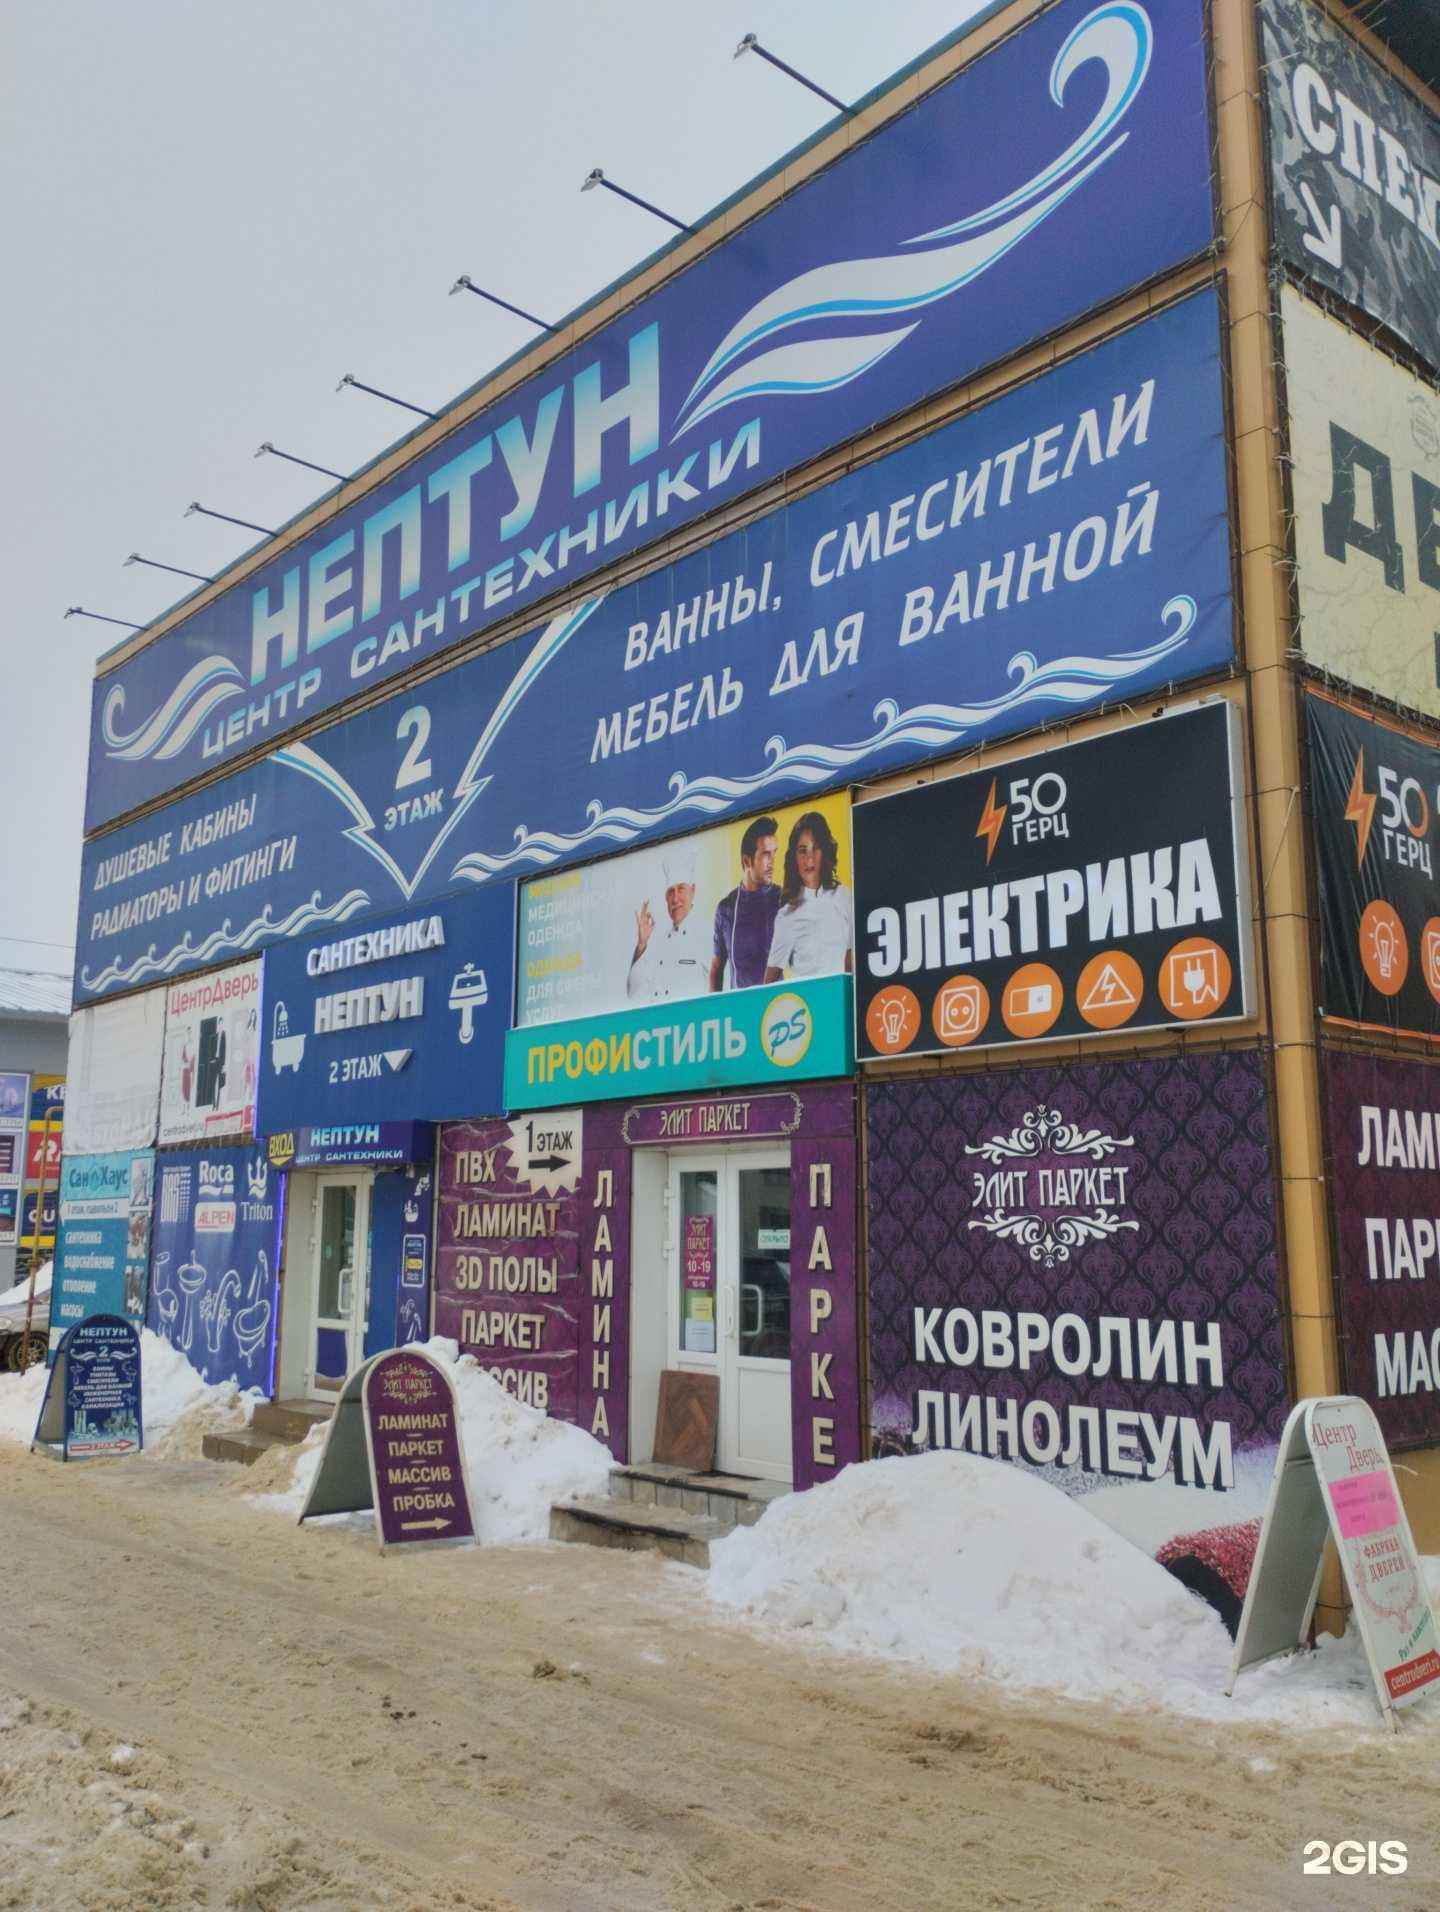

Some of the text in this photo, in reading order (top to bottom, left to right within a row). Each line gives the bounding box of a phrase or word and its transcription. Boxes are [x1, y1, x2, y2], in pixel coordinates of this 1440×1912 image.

[251, 321, 660, 688] НЕПТУН
[624, 380, 1155, 671] ВАННЫ, СМЕСИТЕЛИ
[203, 418, 761, 760] ЦЕНТР САНТЕХНИКИ
[590, 481, 1160, 764] МЕБЕЛЬ ДЛЯ ВАННОЙ
[396, 705, 432, 790] 2
[384, 788, 445, 832] ЭТАЖ
[1009, 772, 1067, 823] 50
[1378, 765, 1429, 838] 50
[94, 794, 257, 891] ДУШЕВЫЕ КАБИНЫ
[1012, 812, 1070, 846] ГЕРЦ
[1382, 829, 1432, 881] ГЕРЦ
[90, 836, 297, 941] РАДИАТОРЫ И ФИТИНГИ
[867, 838, 1223, 978] ЭЛЕКТРИКА
[307, 915, 446, 977] САНТЕХНИКА
[314, 976, 425, 1035] НЕПТУН
[328, 1054, 383, 1084] 2 ЭТАЖ
[527, 1016, 747, 1085] ПРОФИСТИЛЬ
[310, 1124, 380, 1147] НЕПТУН
[525, 1121, 573, 1153] 1 ЭТАЖ
[659, 1102, 751, 1137] ЭЛИТ ПАРКЕТ
[269, 1132, 295, 1157] ВХОД
[325, 1149, 403, 1161] САНТЕХНИКИ
[199, 1161, 235, 1185] Roca
[455, 1150, 497, 1184] ПВХ
[973, 1166, 1128, 1208] ЭЛИТ ПАРКЕТ
[241, 1202, 273, 1221] Triton
[453, 1202, 560, 1239] ЛАМИНАТ
[1365, 1217, 1440, 1281] ПАР
[455, 1255, 558, 1293] 3D ПОЛЫ
[79, 1326, 129, 1337] НЕПТУН
[461, 1310, 545, 1350] ПАРКЕТ
[914, 1306, 1224, 1388] КОВРОЛИН
[98, 1345, 109, 1358] 2
[378, 1413, 449, 1431] ЛАМИНАТ
[912, 1389, 1235, 1489] ЛИНОЛЕУМ
[388, 1440, 445, 1457] ПАРКЕТ
[388, 1466, 452, 1485] МАССИВ
[392, 1492, 456, 1513] ПРОБКА
